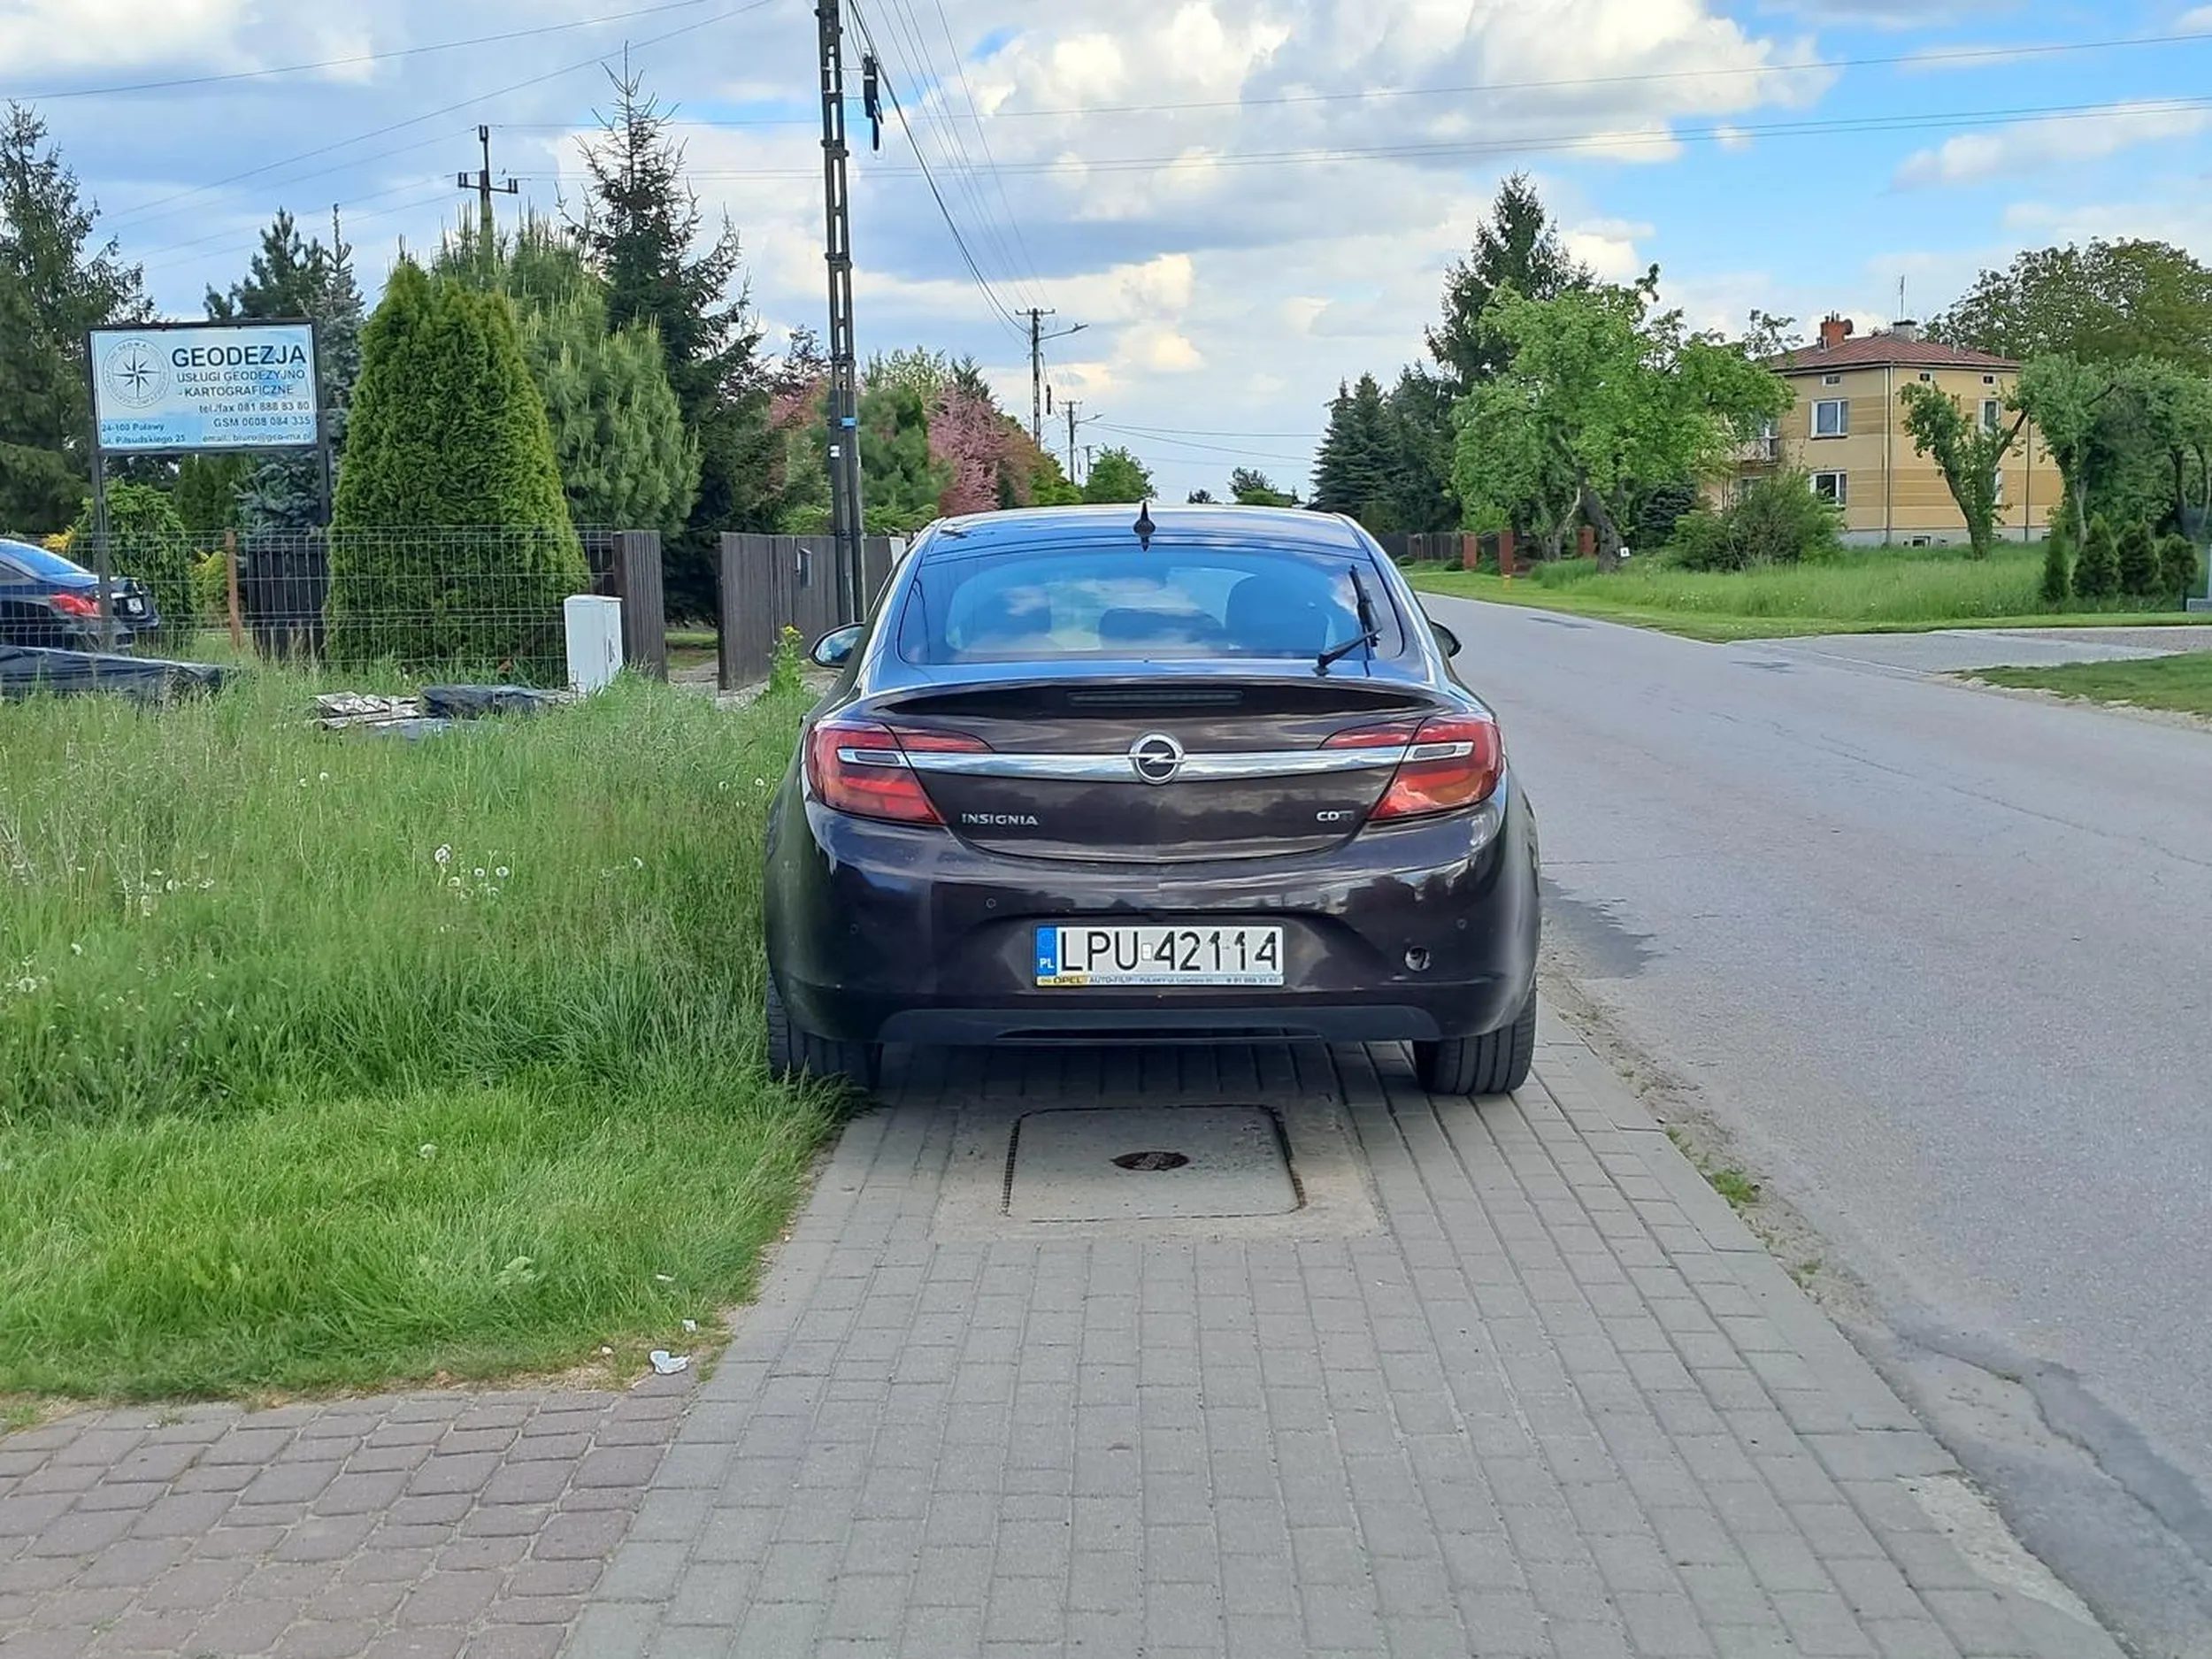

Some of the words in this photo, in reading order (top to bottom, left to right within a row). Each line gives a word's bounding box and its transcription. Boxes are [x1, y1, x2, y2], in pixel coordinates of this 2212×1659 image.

[172, 345, 307, 367] GEODEZJA
[177, 372, 220, 383] USŁUGI
[224, 369, 305, 382] GEODEZYJNO
[237, 403, 256, 412] 081
[213, 417, 239, 427] GSM
[962, 813, 1039, 826] INSIGNIA
[1061, 931, 1139, 971] LPU
[1154, 931, 1277, 971] 42114
[1039, 957, 1056, 969] PL
[1053, 975, 1084, 984] OPEL
